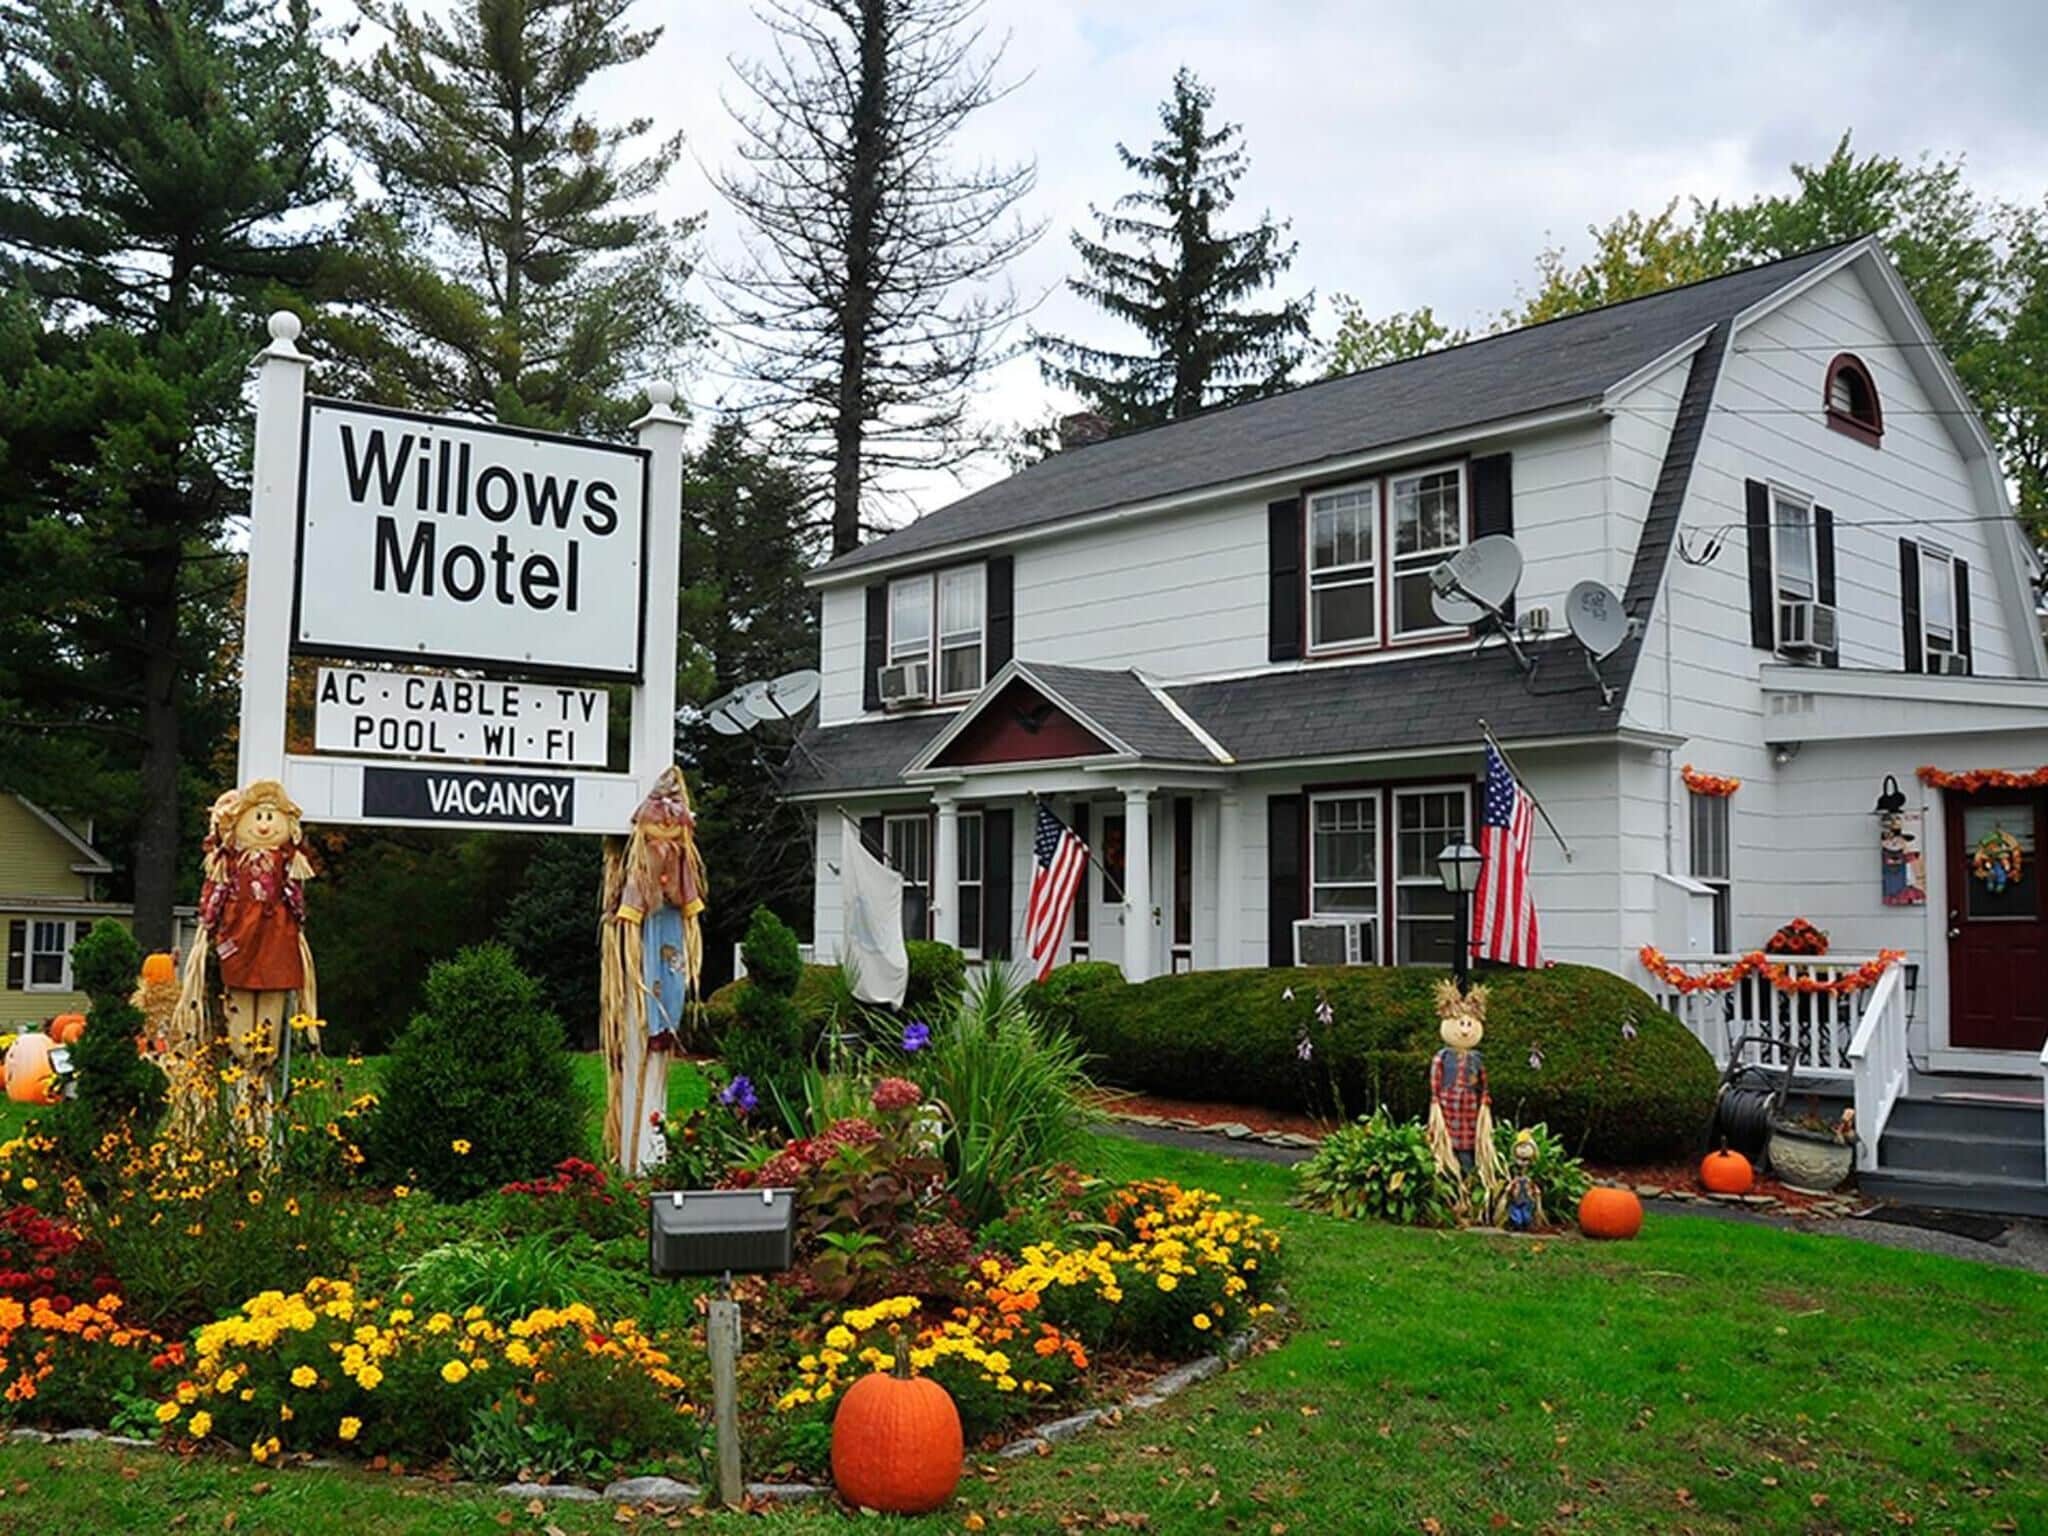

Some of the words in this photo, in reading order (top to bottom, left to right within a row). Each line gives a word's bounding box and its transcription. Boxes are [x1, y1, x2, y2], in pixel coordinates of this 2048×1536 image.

[340, 424, 618, 536] Willows
[374, 516, 579, 612] Motel
[321, 672, 366, 706] AC
[405, 679, 519, 717] CABLE
[556, 690, 597, 722] TV
[354, 716, 446, 753] POOL
[427, 778, 570, 818] VACANCY
